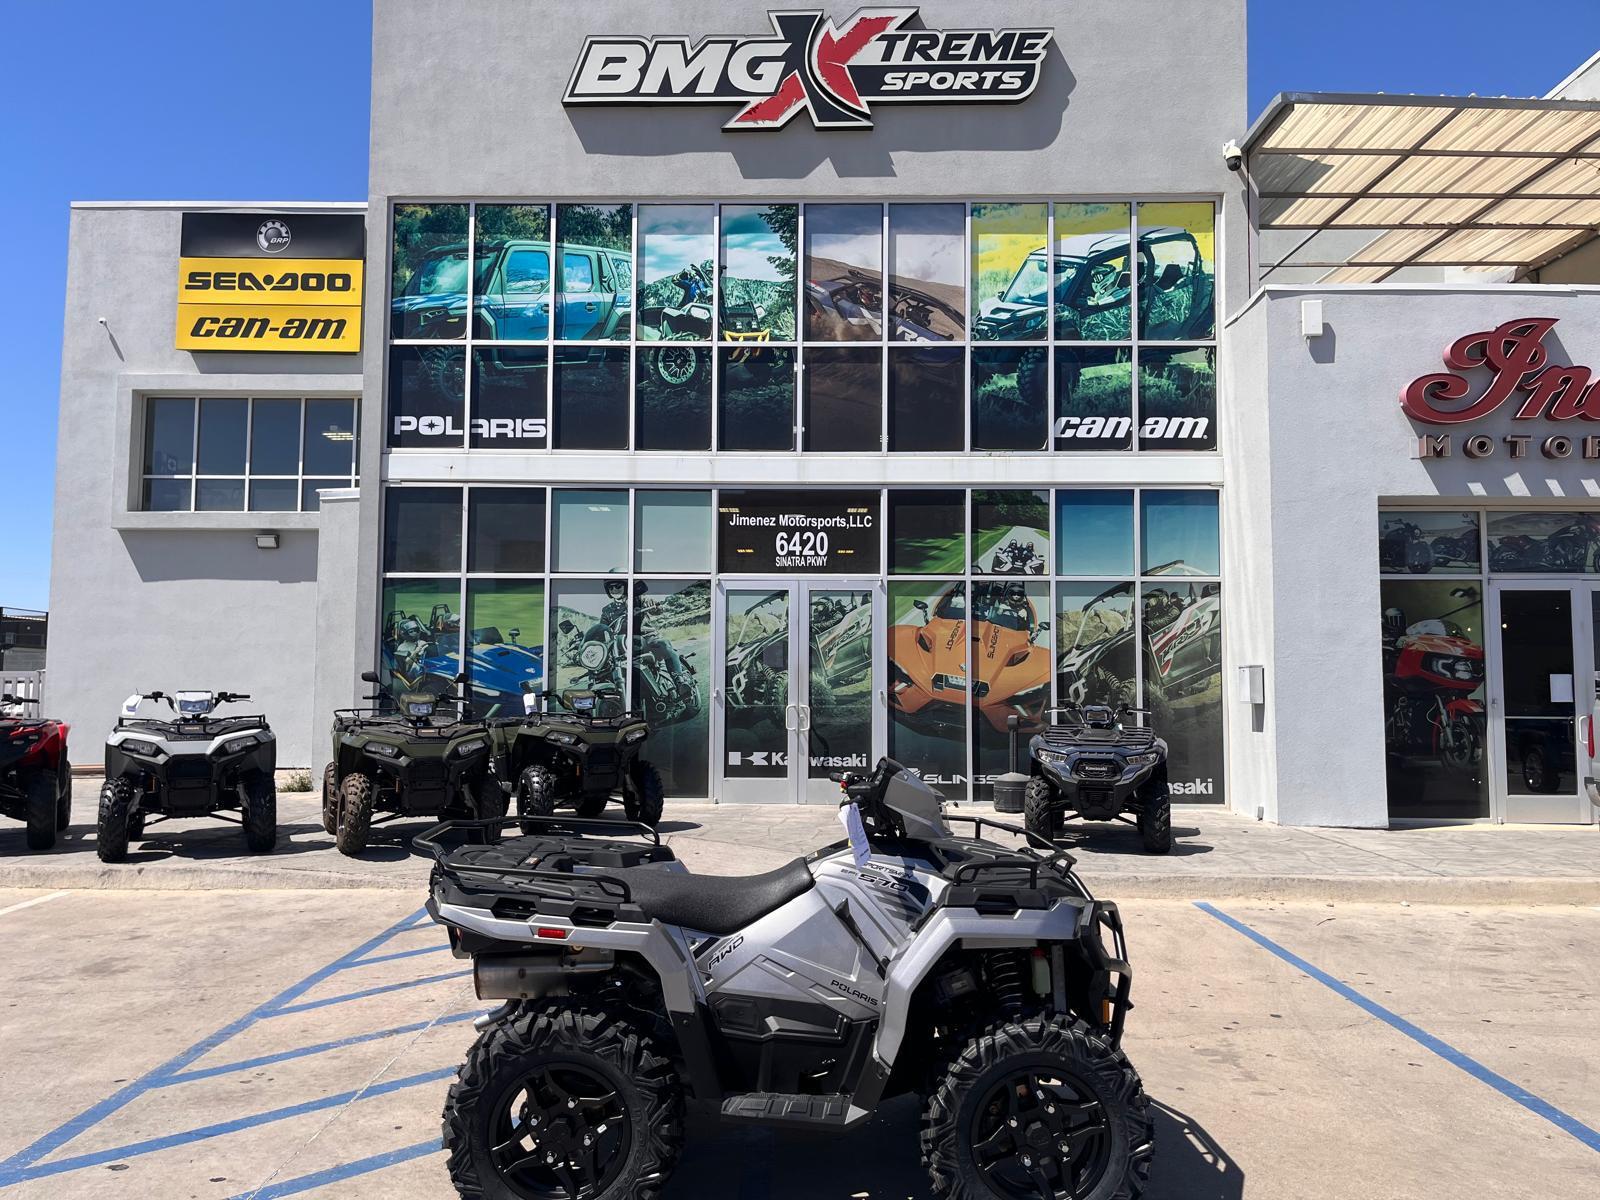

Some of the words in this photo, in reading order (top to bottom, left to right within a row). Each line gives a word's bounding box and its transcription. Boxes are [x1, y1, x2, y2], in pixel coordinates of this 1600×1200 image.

[573, 41, 791, 94] BMG
[880, 69, 1027, 91] SPORTS
[190, 316, 347, 340] can-am
[1399, 317, 1600, 424] In
[394, 415, 547, 438] POLARIS
[729, 514, 776, 527] Jimenez
[775, 531, 829, 556] 6420
[775, 555, 805, 567] SINATRA
[806, 556, 828, 567] PKWY
[771, 751, 867, 768] Kawasaki
[923, 774, 1001, 785] SLINGS
[708, 935, 744, 970] AWD
[830, 979, 879, 1007] POLARIS
